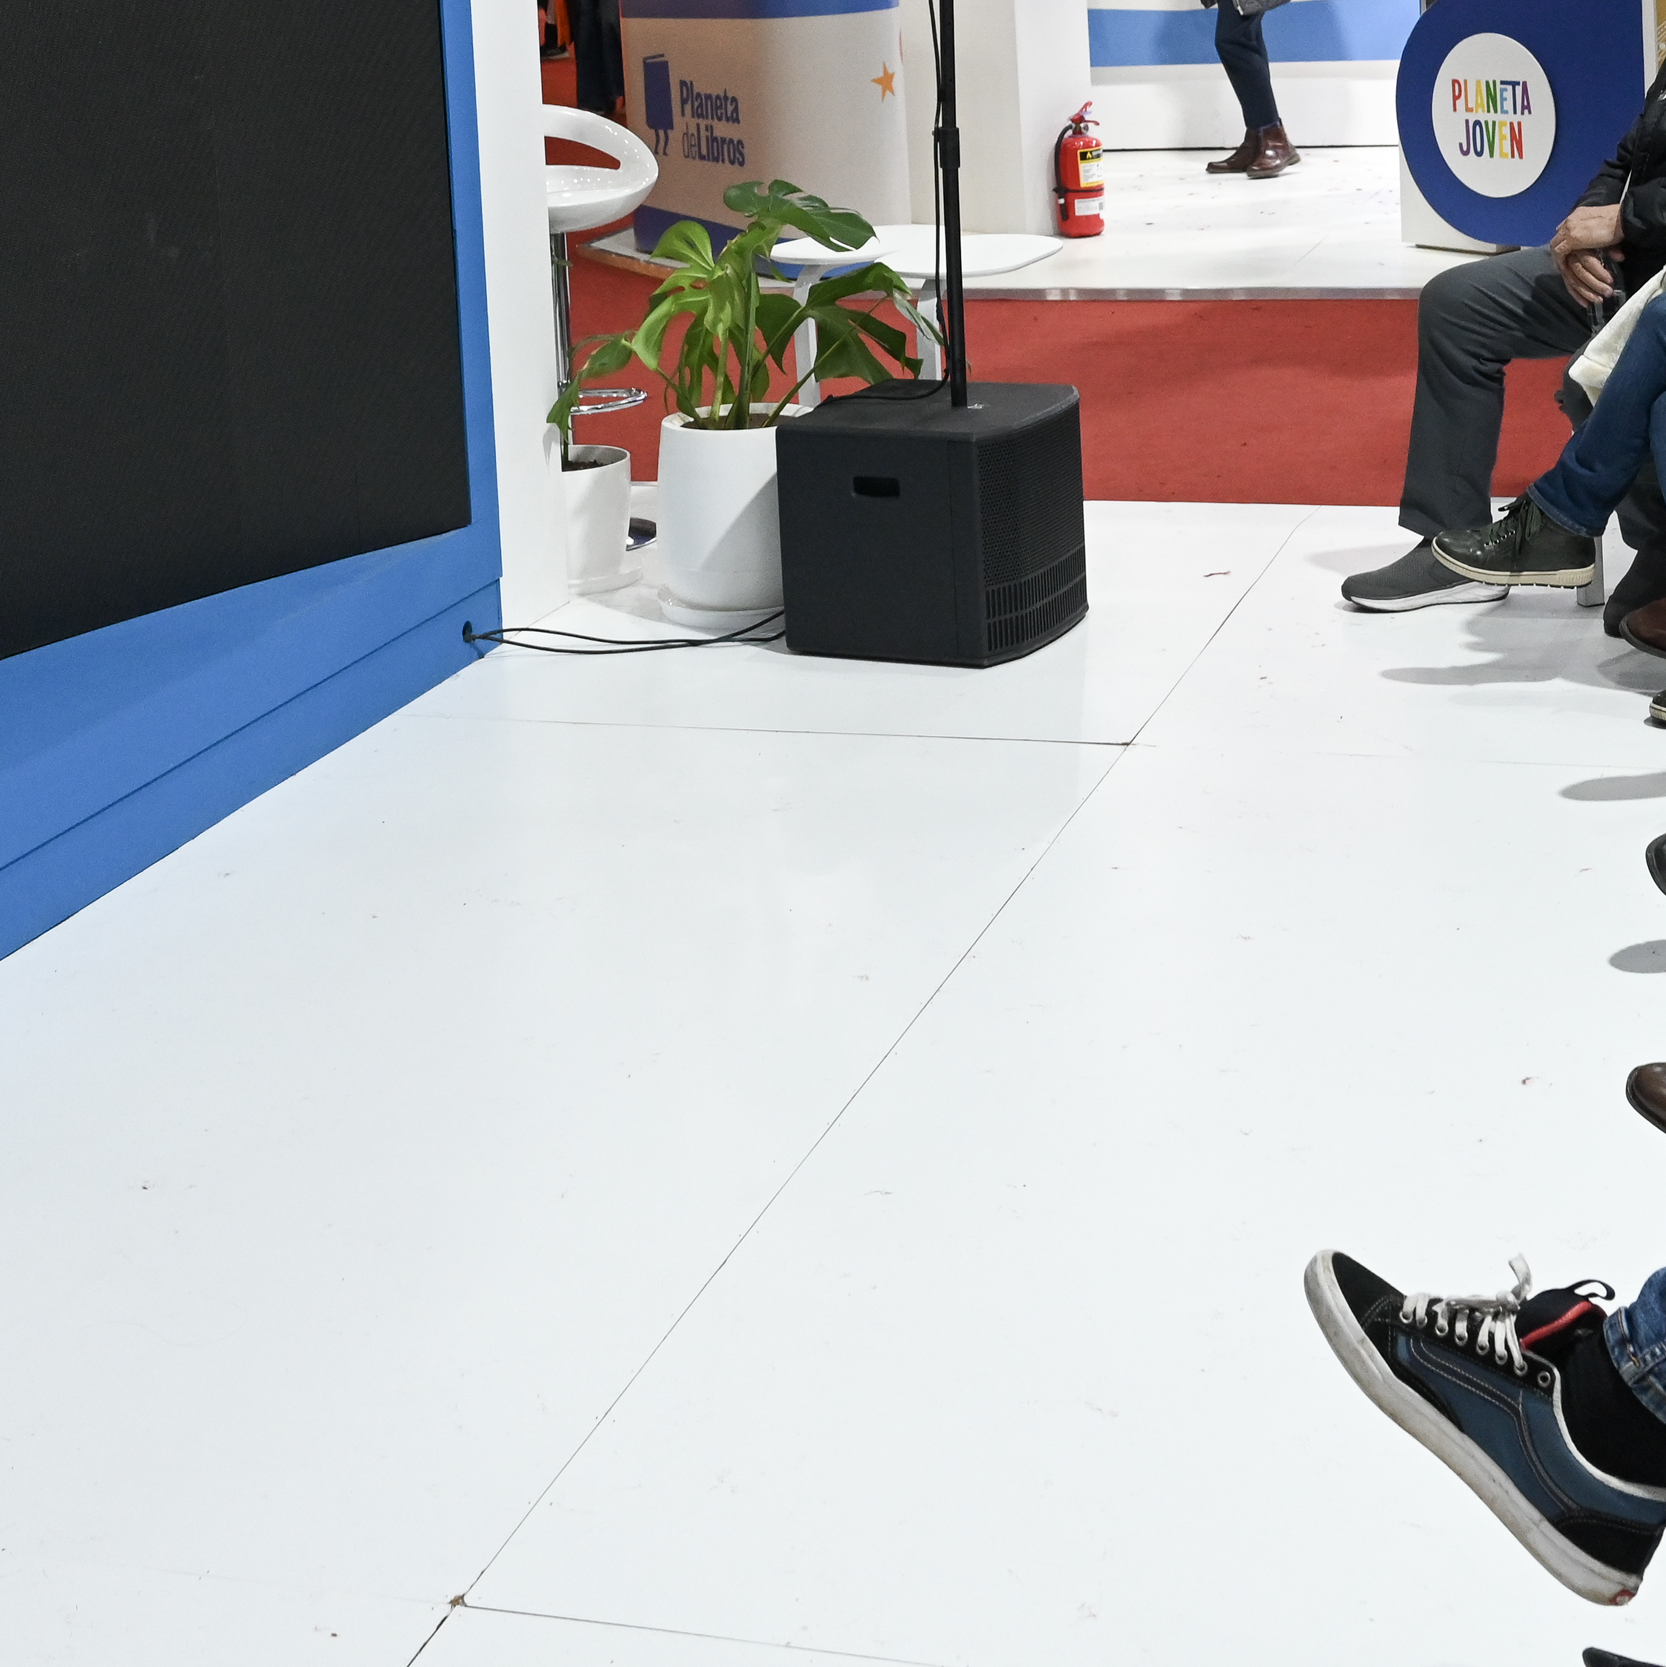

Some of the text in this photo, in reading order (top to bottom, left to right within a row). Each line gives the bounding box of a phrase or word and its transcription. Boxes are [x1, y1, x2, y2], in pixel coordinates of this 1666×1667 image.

[679, 79, 740, 124] Planeta
[1451, 79, 1532, 115] PLANETA
[1459, 119, 1524, 159] JOVEN
